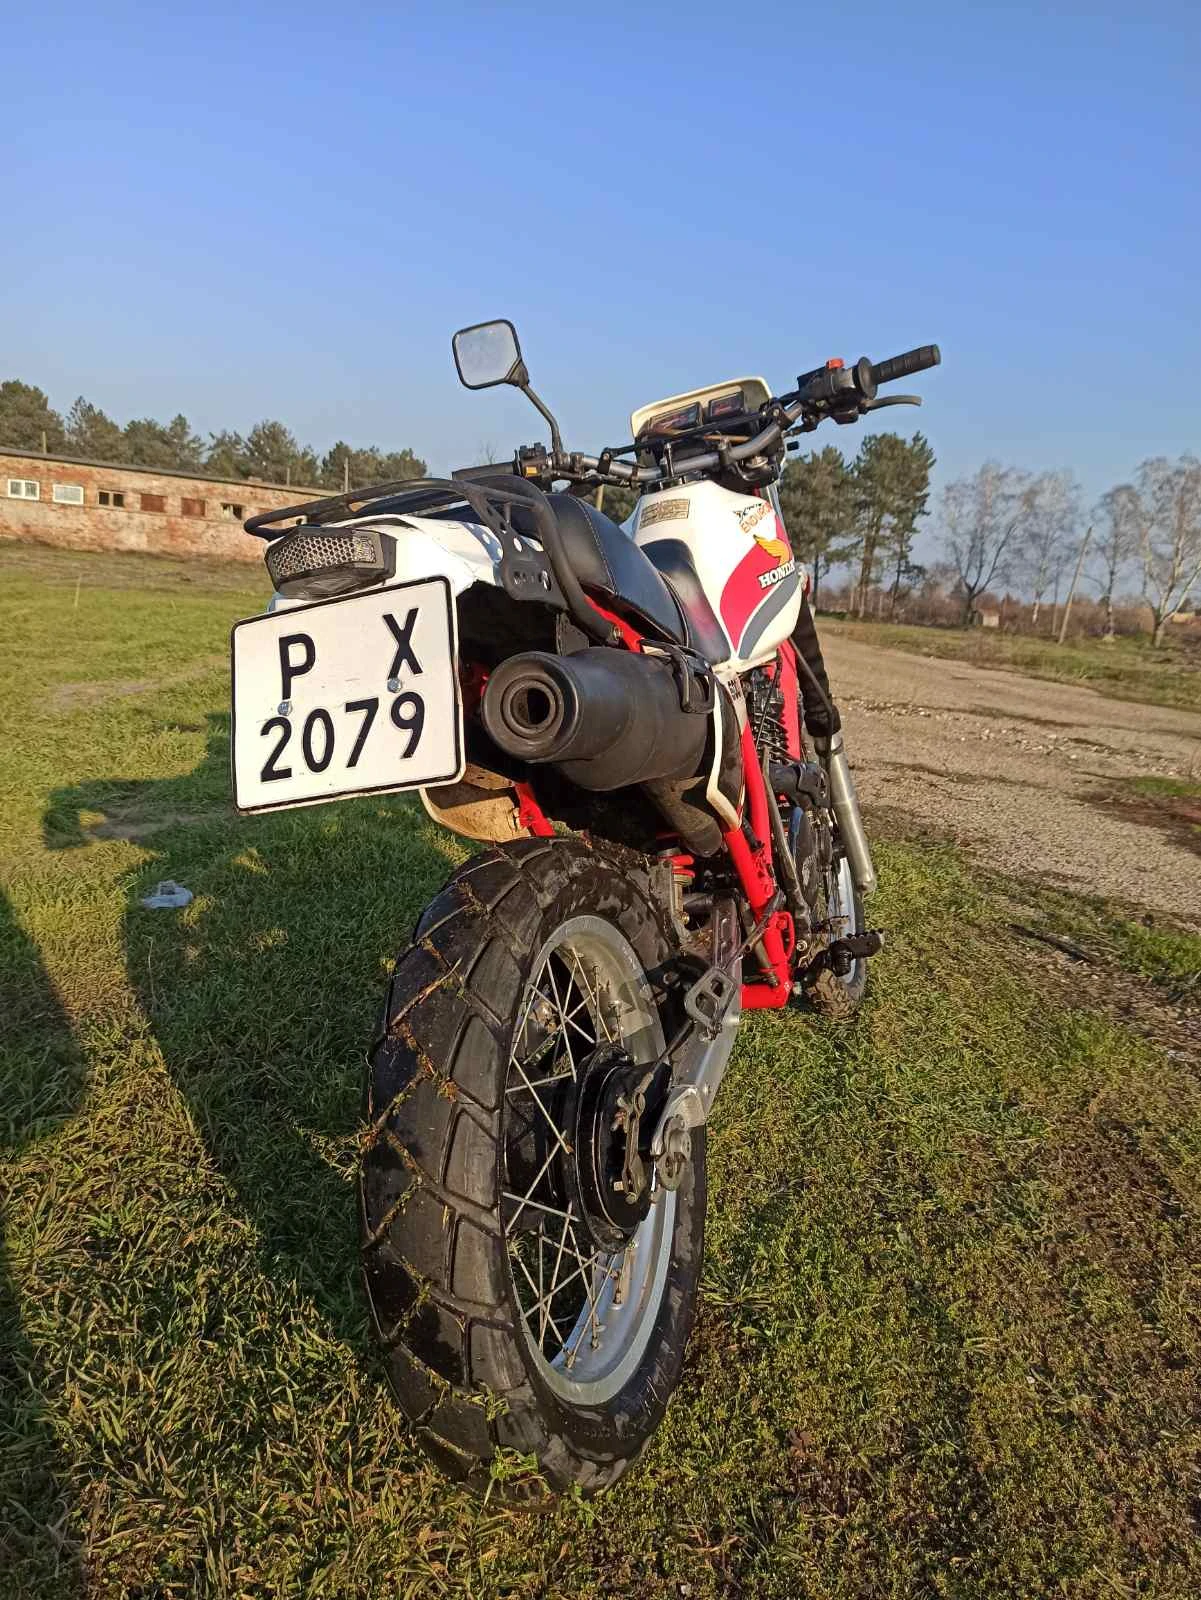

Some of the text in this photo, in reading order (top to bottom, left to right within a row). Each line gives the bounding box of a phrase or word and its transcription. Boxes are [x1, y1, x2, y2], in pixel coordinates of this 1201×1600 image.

[758, 560, 796, 589] HONDA
[278, 607, 423, 700] P X
[260, 691, 425, 783] 2079
